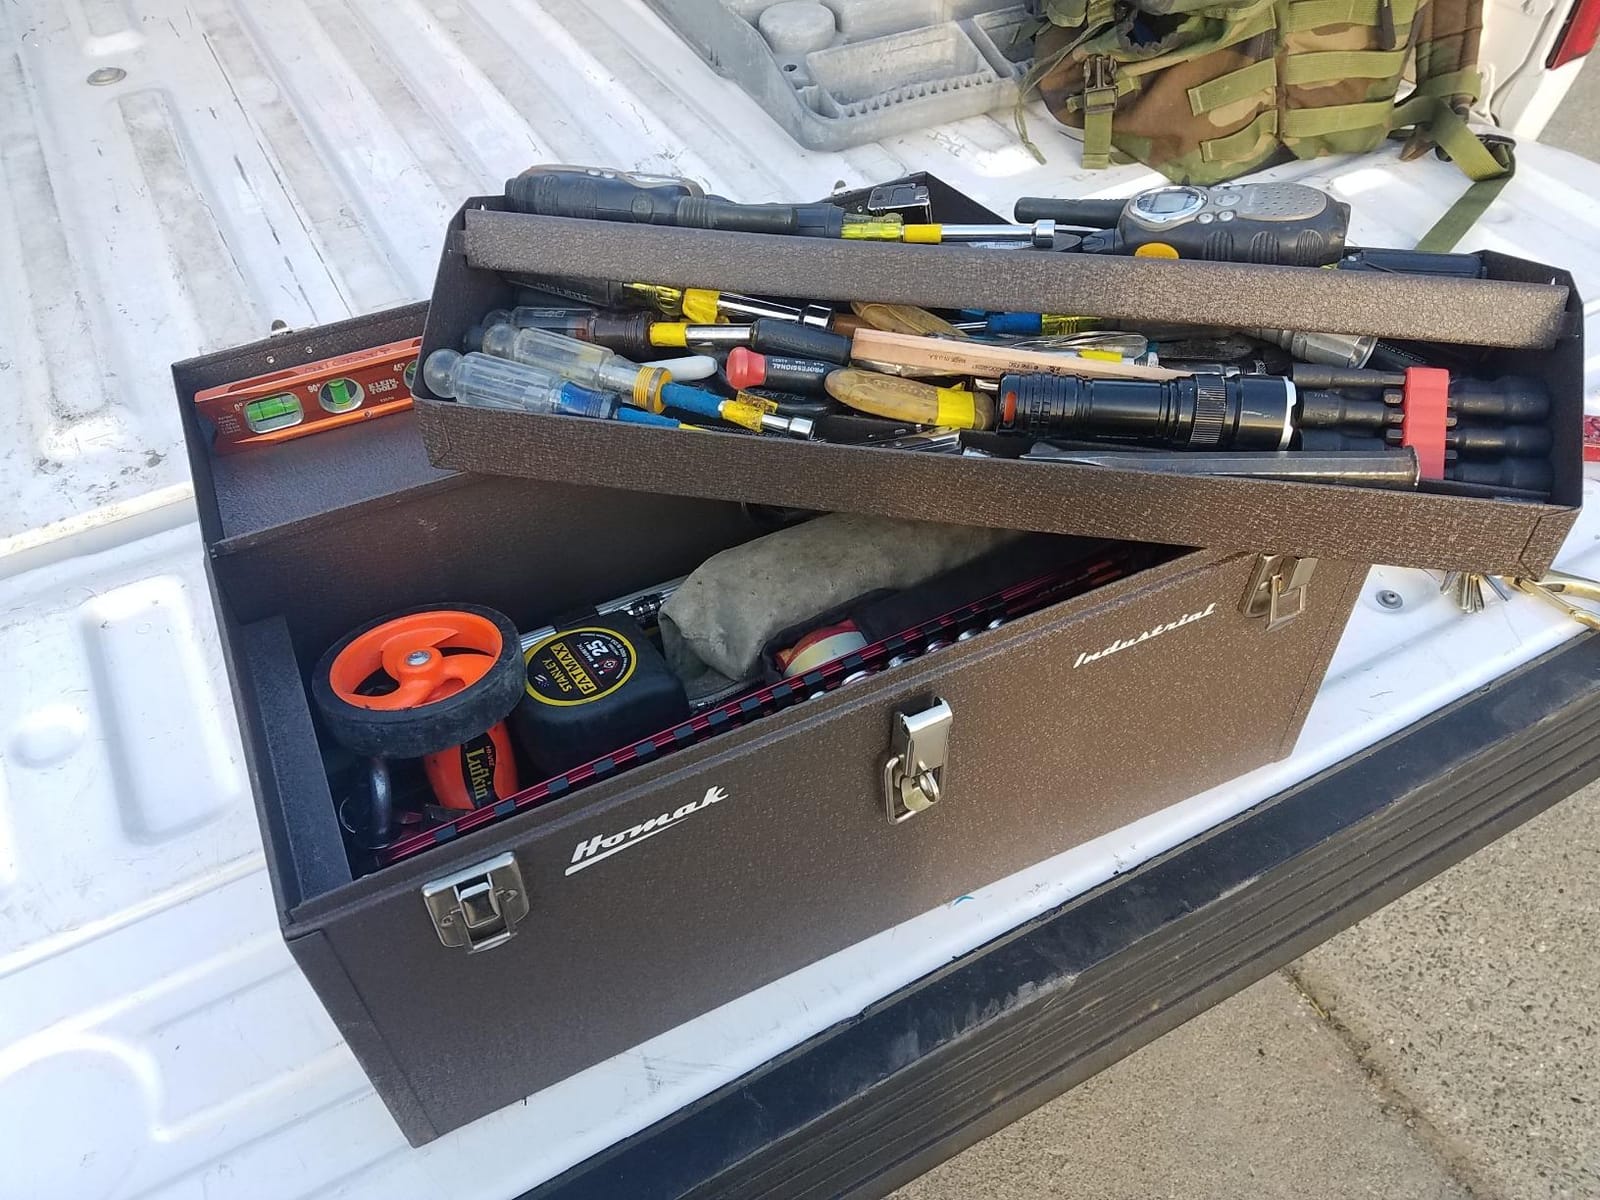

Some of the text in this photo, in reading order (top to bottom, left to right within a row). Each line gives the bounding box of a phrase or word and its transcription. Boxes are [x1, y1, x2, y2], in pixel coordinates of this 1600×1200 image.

[368, 378, 396, 392] KLEIN
[371, 383, 398, 395] TOOLS
[771, 363, 824, 373] PROFESSIONAL
[1073, 602, 1216, 669] Industrial
[542, 658, 572, 692] STANLEY
[554, 643, 596, 694] FATMAX
[466, 747, 492, 800] Lufkin
[570, 785, 729, 864] Homak
